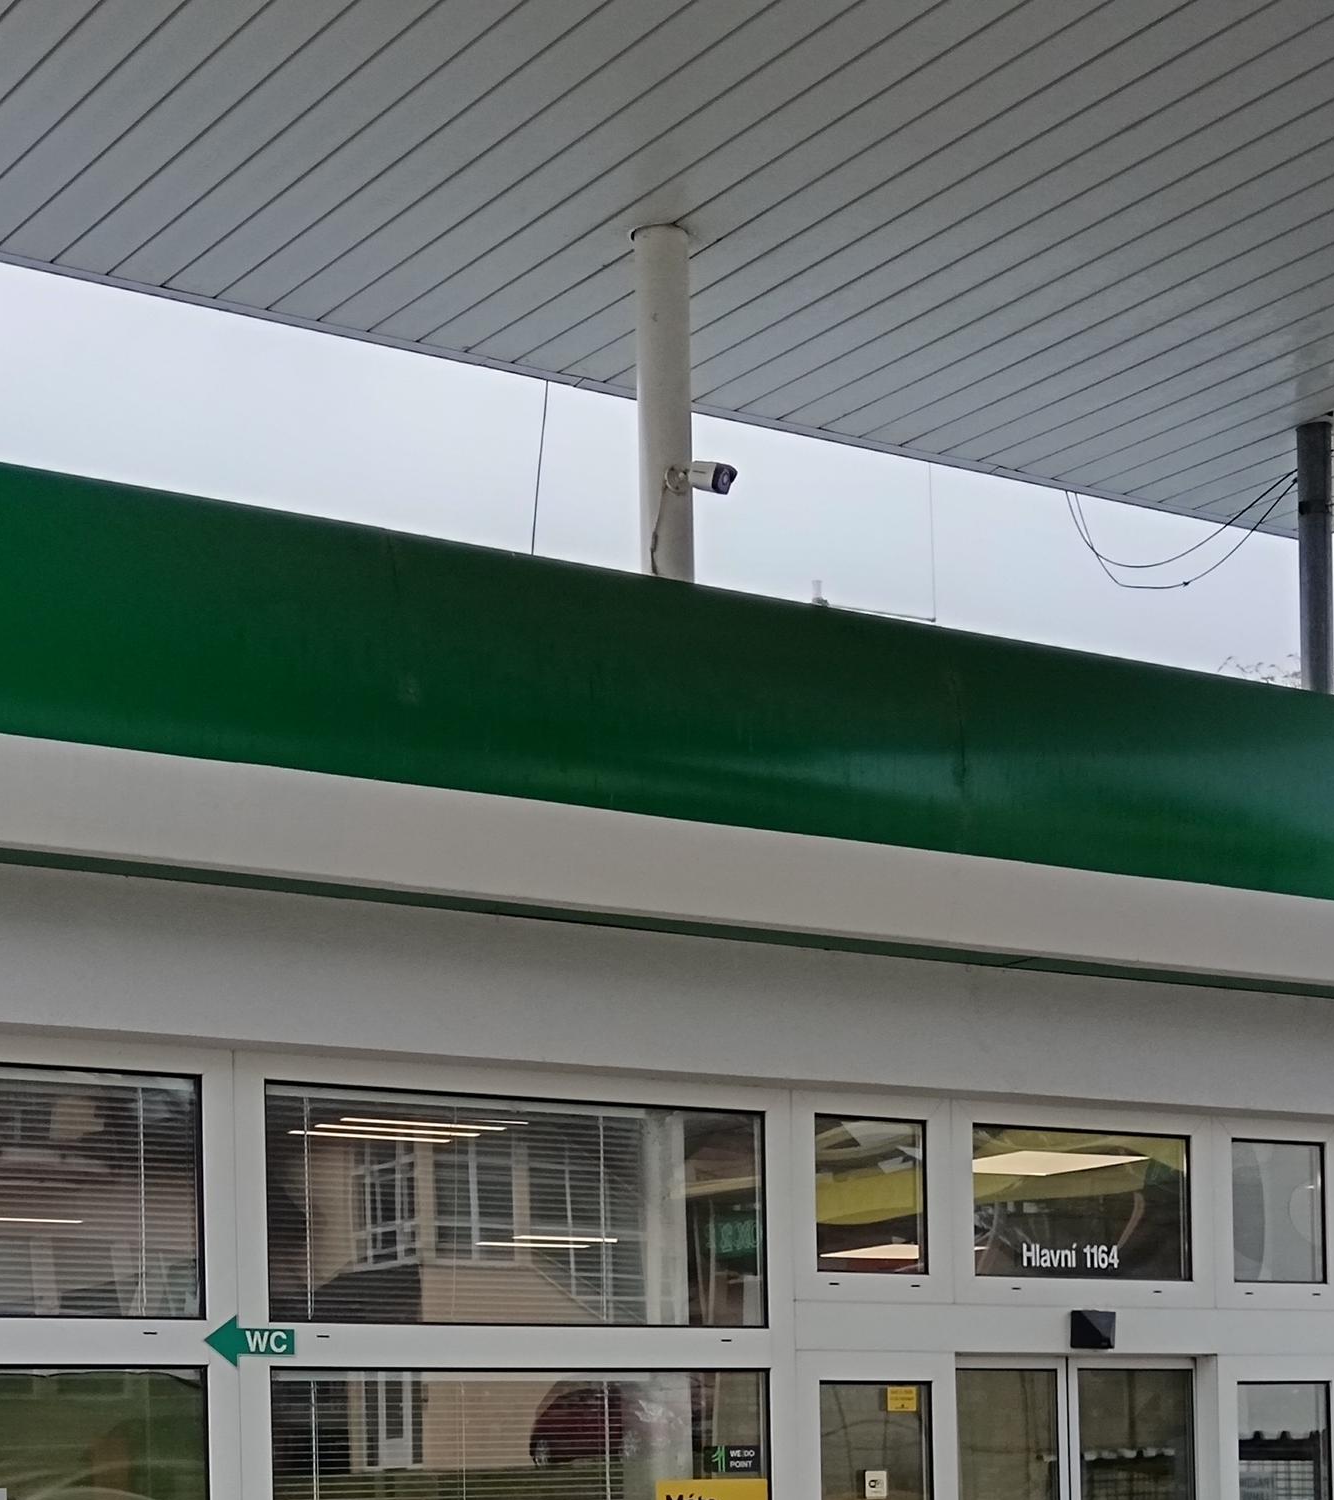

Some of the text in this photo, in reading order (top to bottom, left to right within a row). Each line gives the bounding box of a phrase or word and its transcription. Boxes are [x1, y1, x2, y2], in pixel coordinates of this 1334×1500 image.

[1022, 1242, 1120, 1269] Hlavní 1164
[245, 1330, 288, 1353] WC
[729, 1460, 753, 1469] POINT
